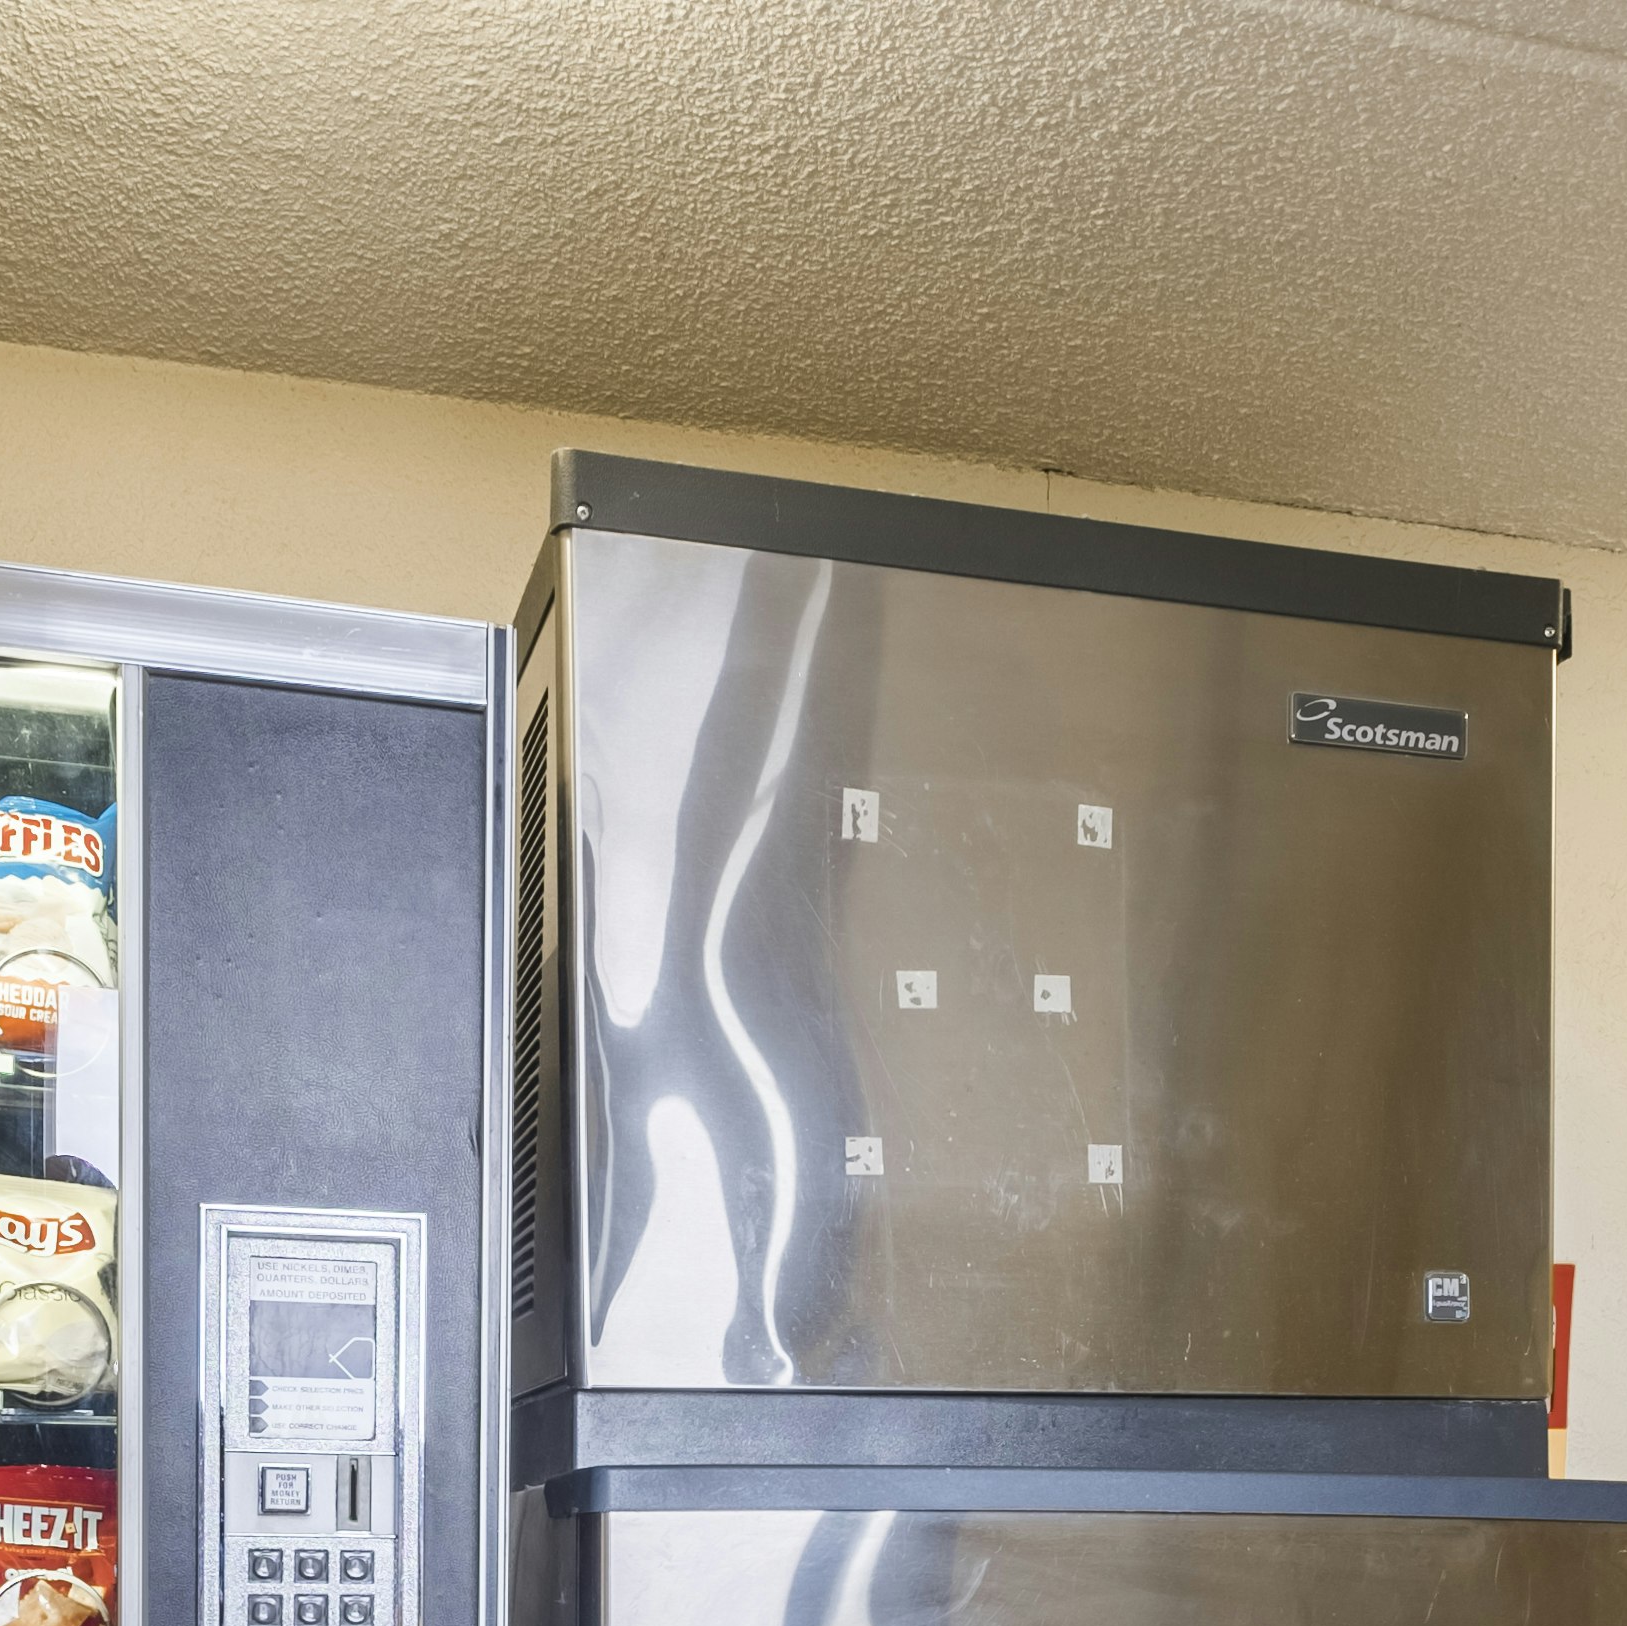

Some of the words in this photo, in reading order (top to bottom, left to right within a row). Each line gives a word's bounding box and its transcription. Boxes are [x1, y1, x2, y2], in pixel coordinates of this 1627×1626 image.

[1324, 716, 1459, 752] Scotsman
[257, 1262, 279, 1272] USE
[259, 1288, 304, 1300] AMOUNT
[307, 1290, 367, 1301] DEPOSITED
[275, 1473, 297, 1481] PUSH
[270, 1498, 302, 1507] RETURN
